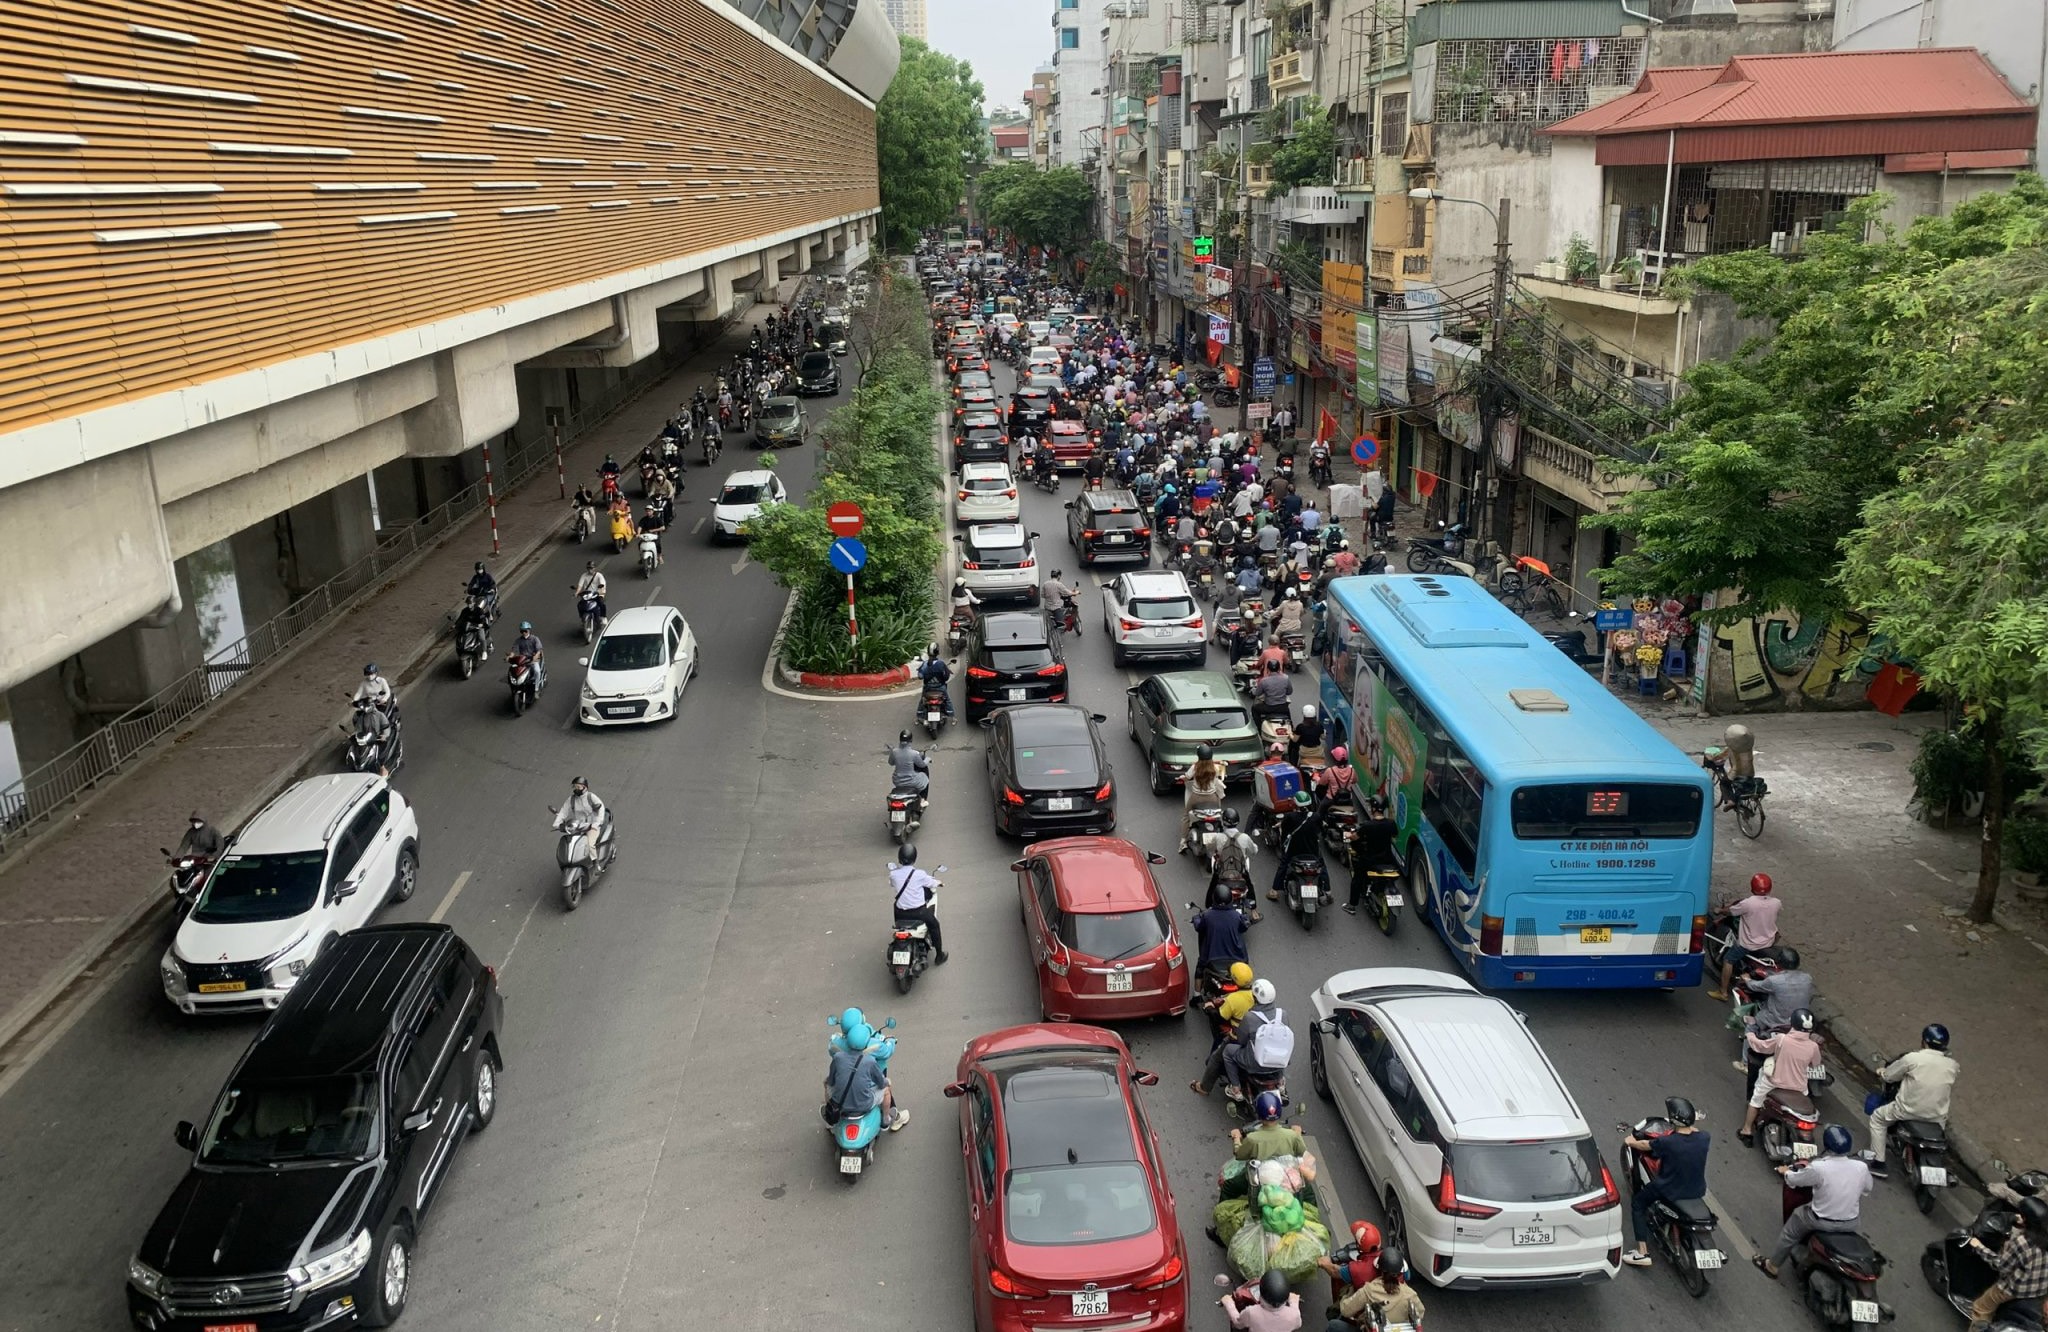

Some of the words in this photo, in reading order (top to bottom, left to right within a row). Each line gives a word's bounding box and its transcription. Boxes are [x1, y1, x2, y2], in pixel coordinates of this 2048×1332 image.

[1256, 364, 1274, 372] NHÀ
[1561, 842, 1573, 851] CT
[1576, 842, 1587, 851] XE
[1615, 840, 1628, 851] HÀ
[1560, 860, 1591, 868] Hotline
[1596, 859, 1656, 868] 1900.1296
[1566, 910, 1587, 920] 29B
[1598, 909, 1635, 919] 400.42
[1518, 1233, 1550, 1244] 394.28
[1074, 1302, 1108, 1316] 278.62
